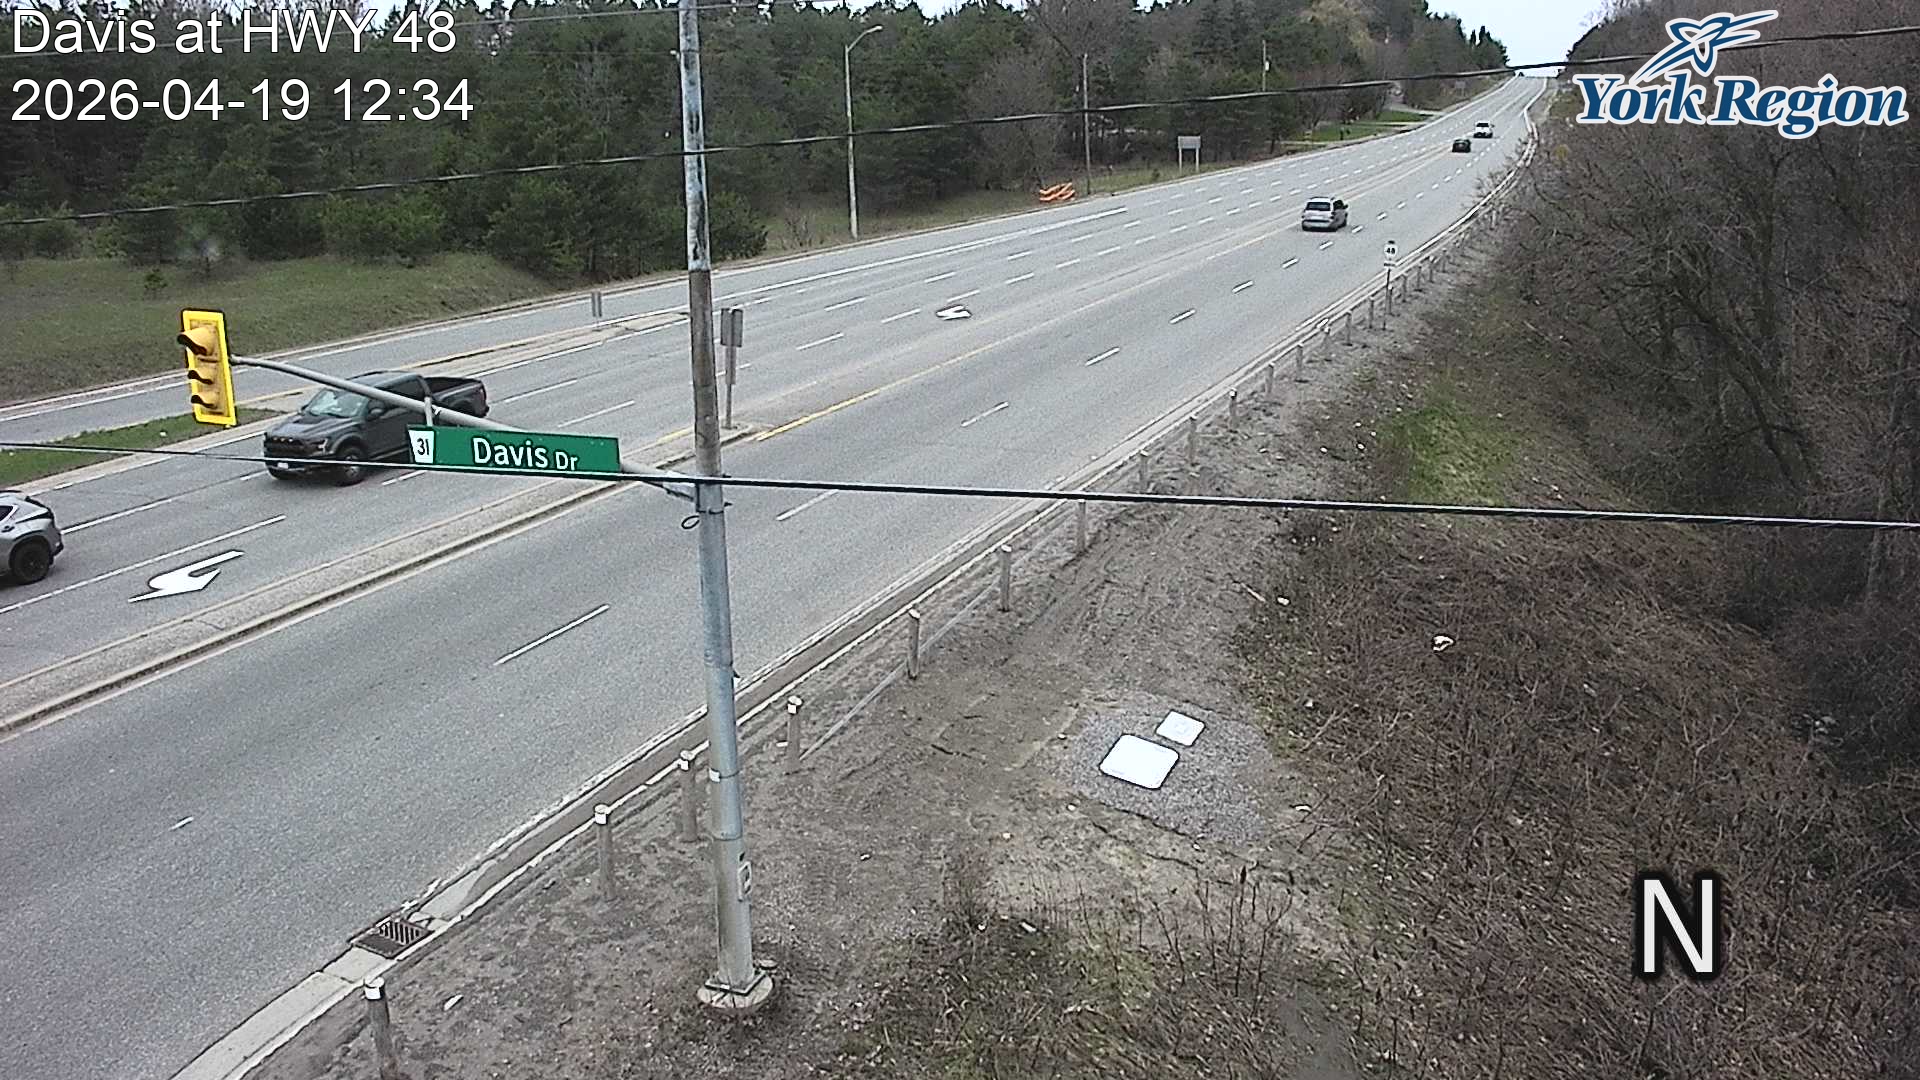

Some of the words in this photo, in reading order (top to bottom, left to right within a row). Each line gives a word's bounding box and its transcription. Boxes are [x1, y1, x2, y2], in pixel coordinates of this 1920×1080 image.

[416, 438, 430, 456] 31
[472, 437, 549, 468] Davis
[555, 451, 578, 471] Dr
